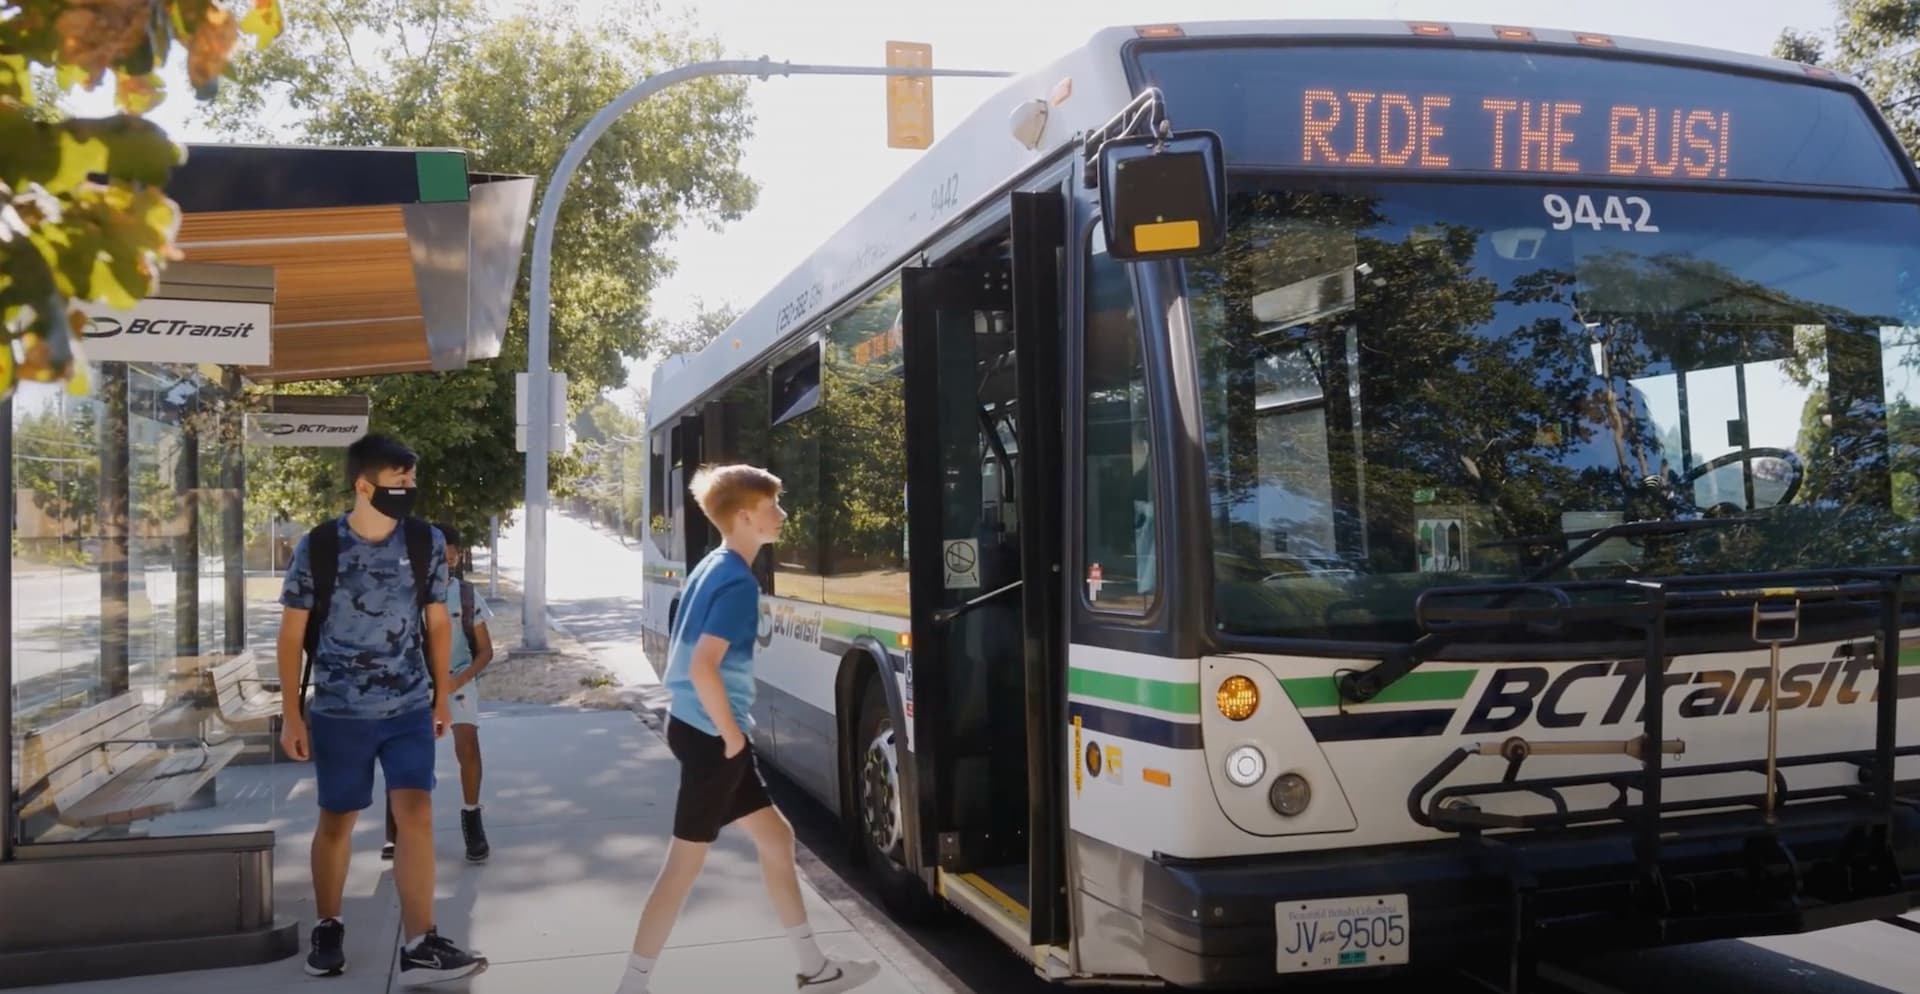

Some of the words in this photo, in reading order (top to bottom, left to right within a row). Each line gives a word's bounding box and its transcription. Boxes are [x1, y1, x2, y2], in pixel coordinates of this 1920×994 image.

[1302, 89, 1452, 168] RIDE
[1482, 98, 1582, 173] THE
[1609, 105, 1730, 178] BUS!
[930, 172, 959, 220] 9442
[1543, 193, 1660, 233] 9442
[125, 318, 255, 338] BCTransit
[296, 424, 359, 433] BCTransit
[774, 605, 822, 645] BCTransit
[1459, 645, 1876, 735] BCTransit
[1285, 921, 1318, 954] JV
[1337, 914, 1405, 951] 9505
